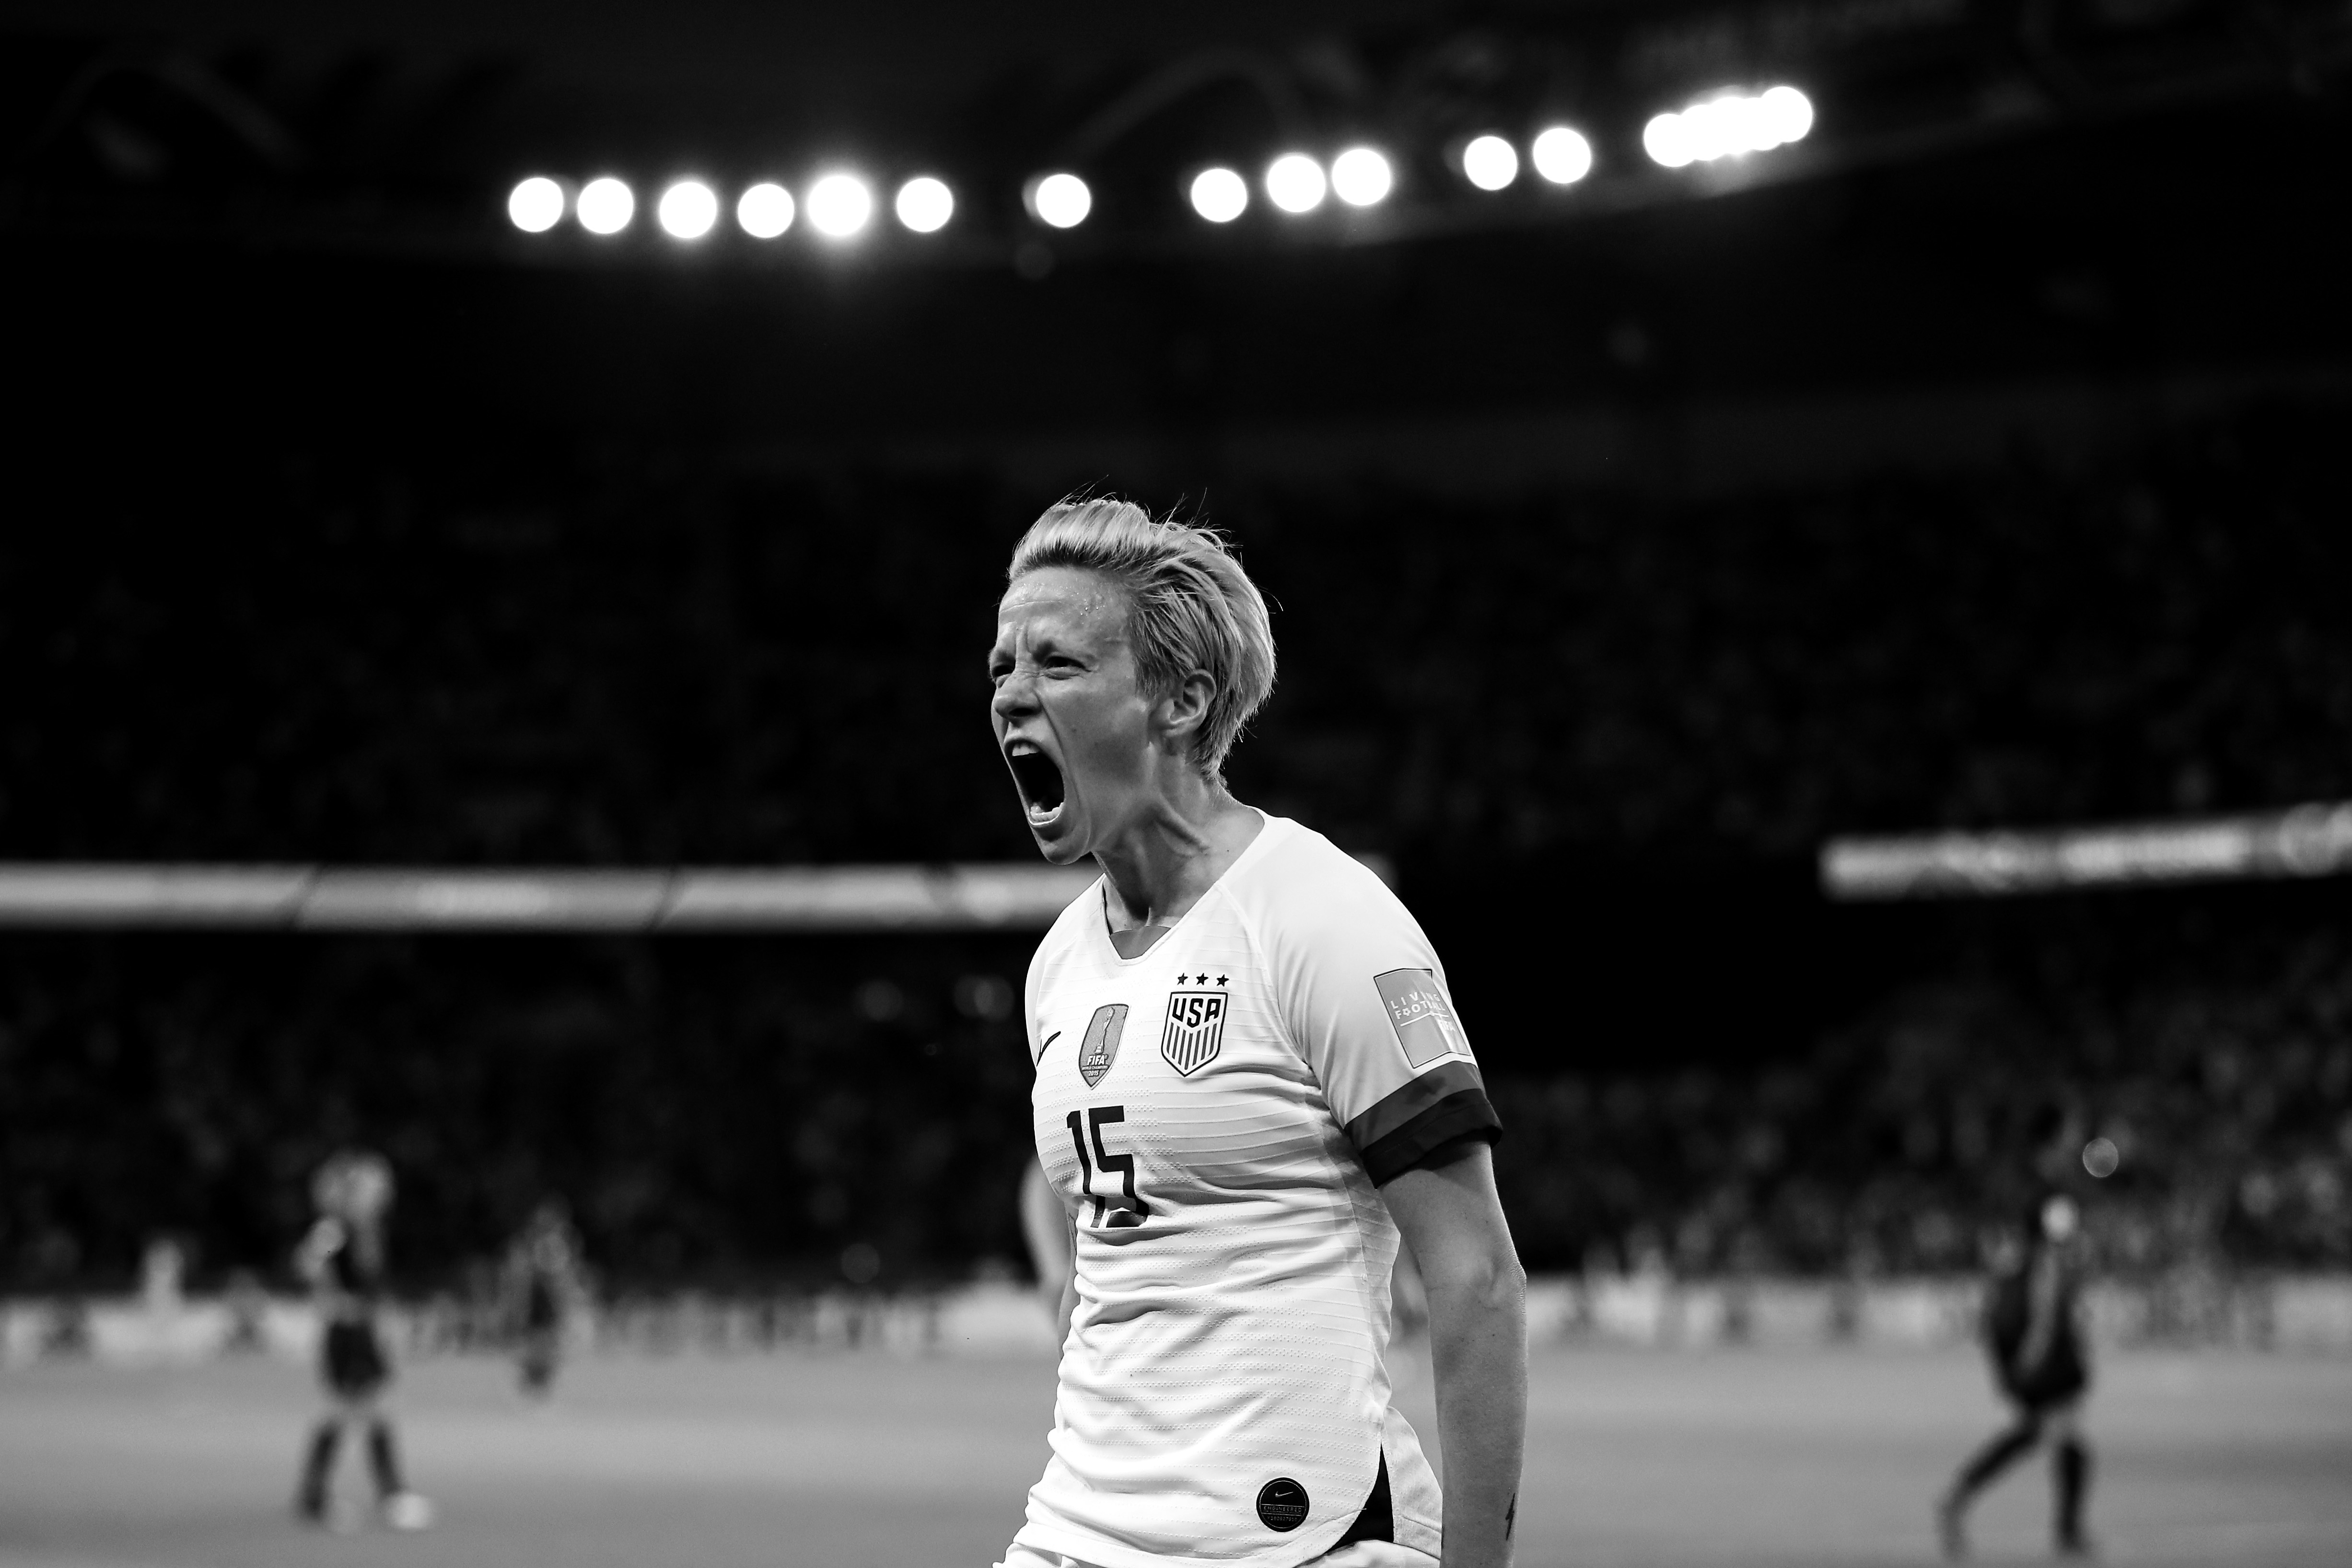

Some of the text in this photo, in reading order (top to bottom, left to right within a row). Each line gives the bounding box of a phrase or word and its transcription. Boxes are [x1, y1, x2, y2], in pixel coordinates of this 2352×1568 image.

[1172, 998, 1222, 1028] USA
[1087, 1055, 1105, 1065] FIFA
[1066, 1105, 1150, 1228] 15
